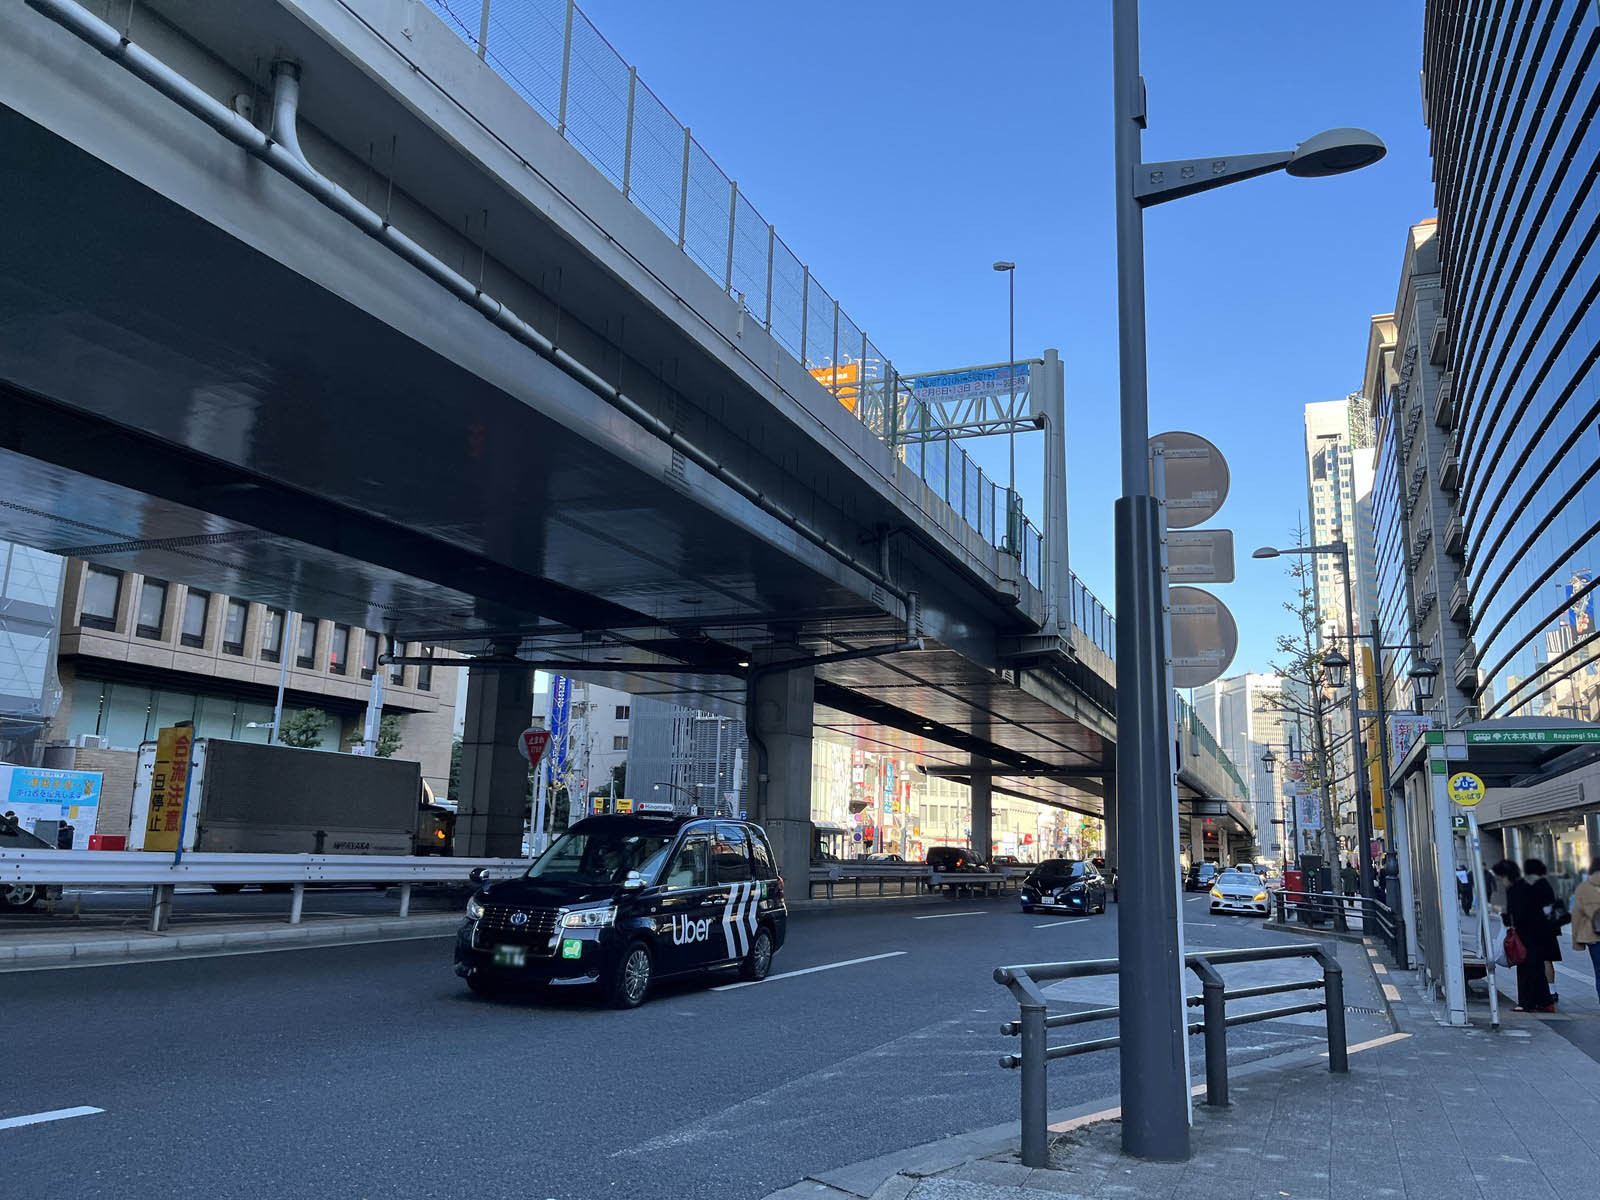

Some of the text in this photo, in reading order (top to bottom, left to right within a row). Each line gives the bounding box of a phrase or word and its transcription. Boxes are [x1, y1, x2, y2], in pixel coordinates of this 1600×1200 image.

[1503, 732, 1545, 740] 六本木駅前
[1553, 732, 1585, 740] Roppongi
[148, 760, 170, 832] 一旦停止
[1455, 817, 1465, 827] P
[672, 914, 712, 946] Uber
